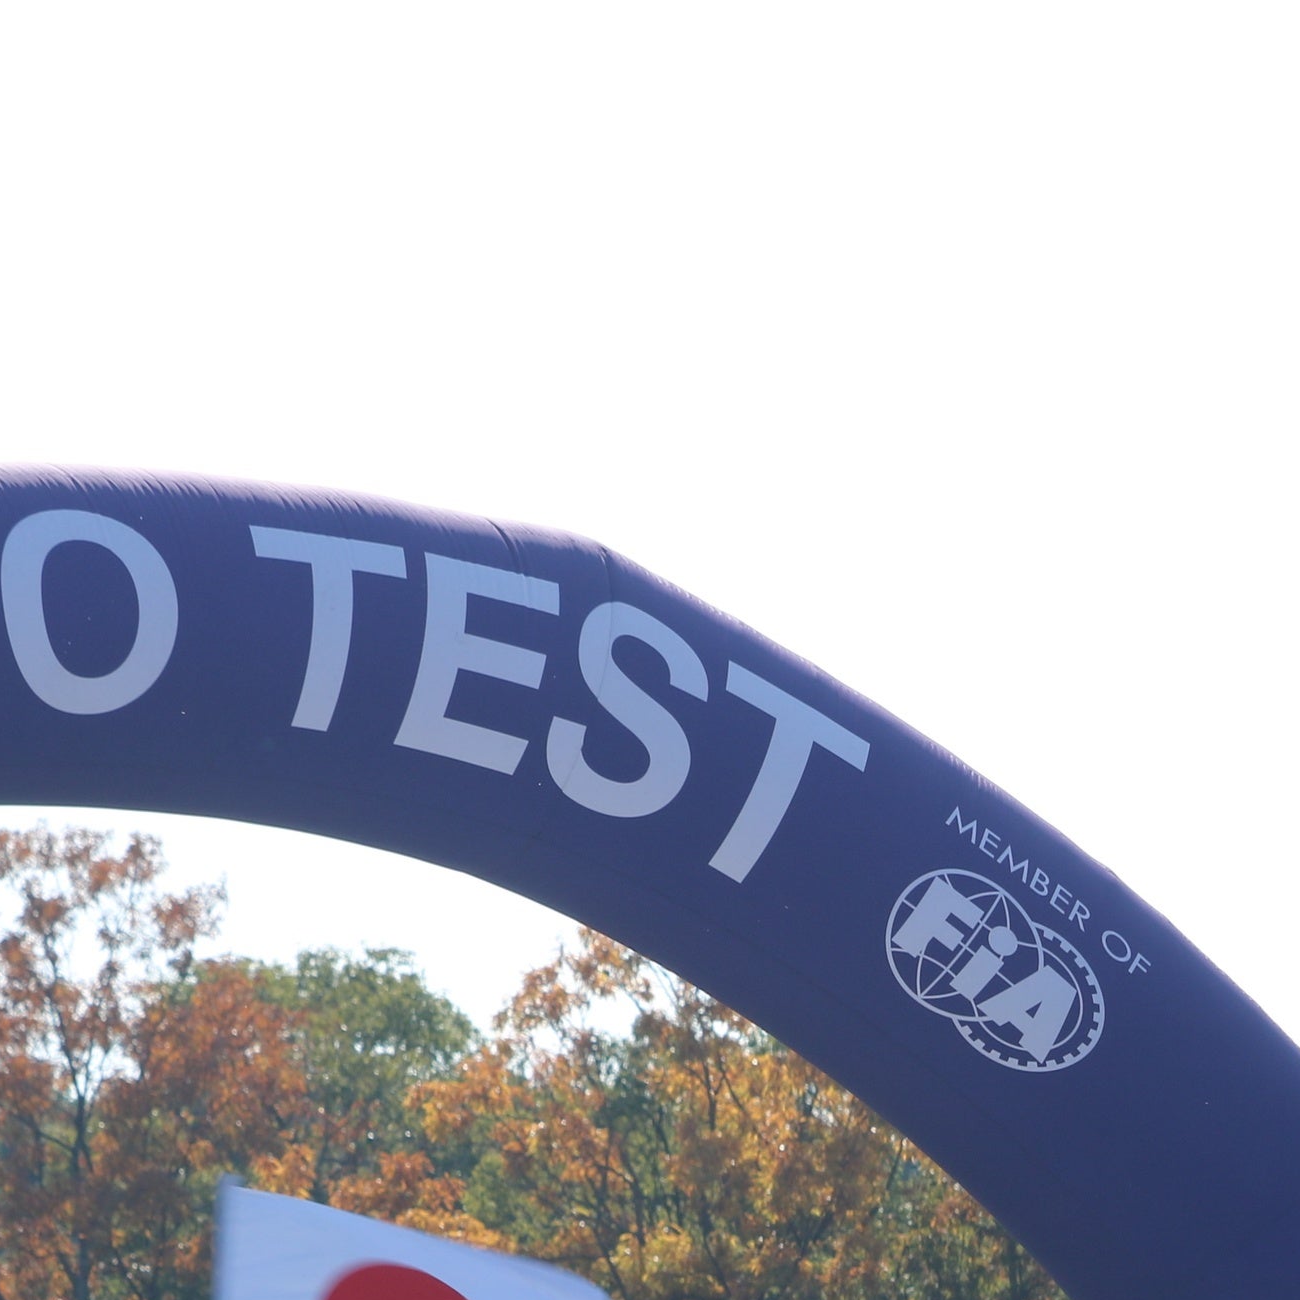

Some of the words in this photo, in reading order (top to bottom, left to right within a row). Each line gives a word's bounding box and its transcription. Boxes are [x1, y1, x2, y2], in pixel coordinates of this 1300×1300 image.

[249, 524, 871, 884] TEST
[945, 806, 1091, 931] MEMBER
[1101, 930, 1151, 974] OF
